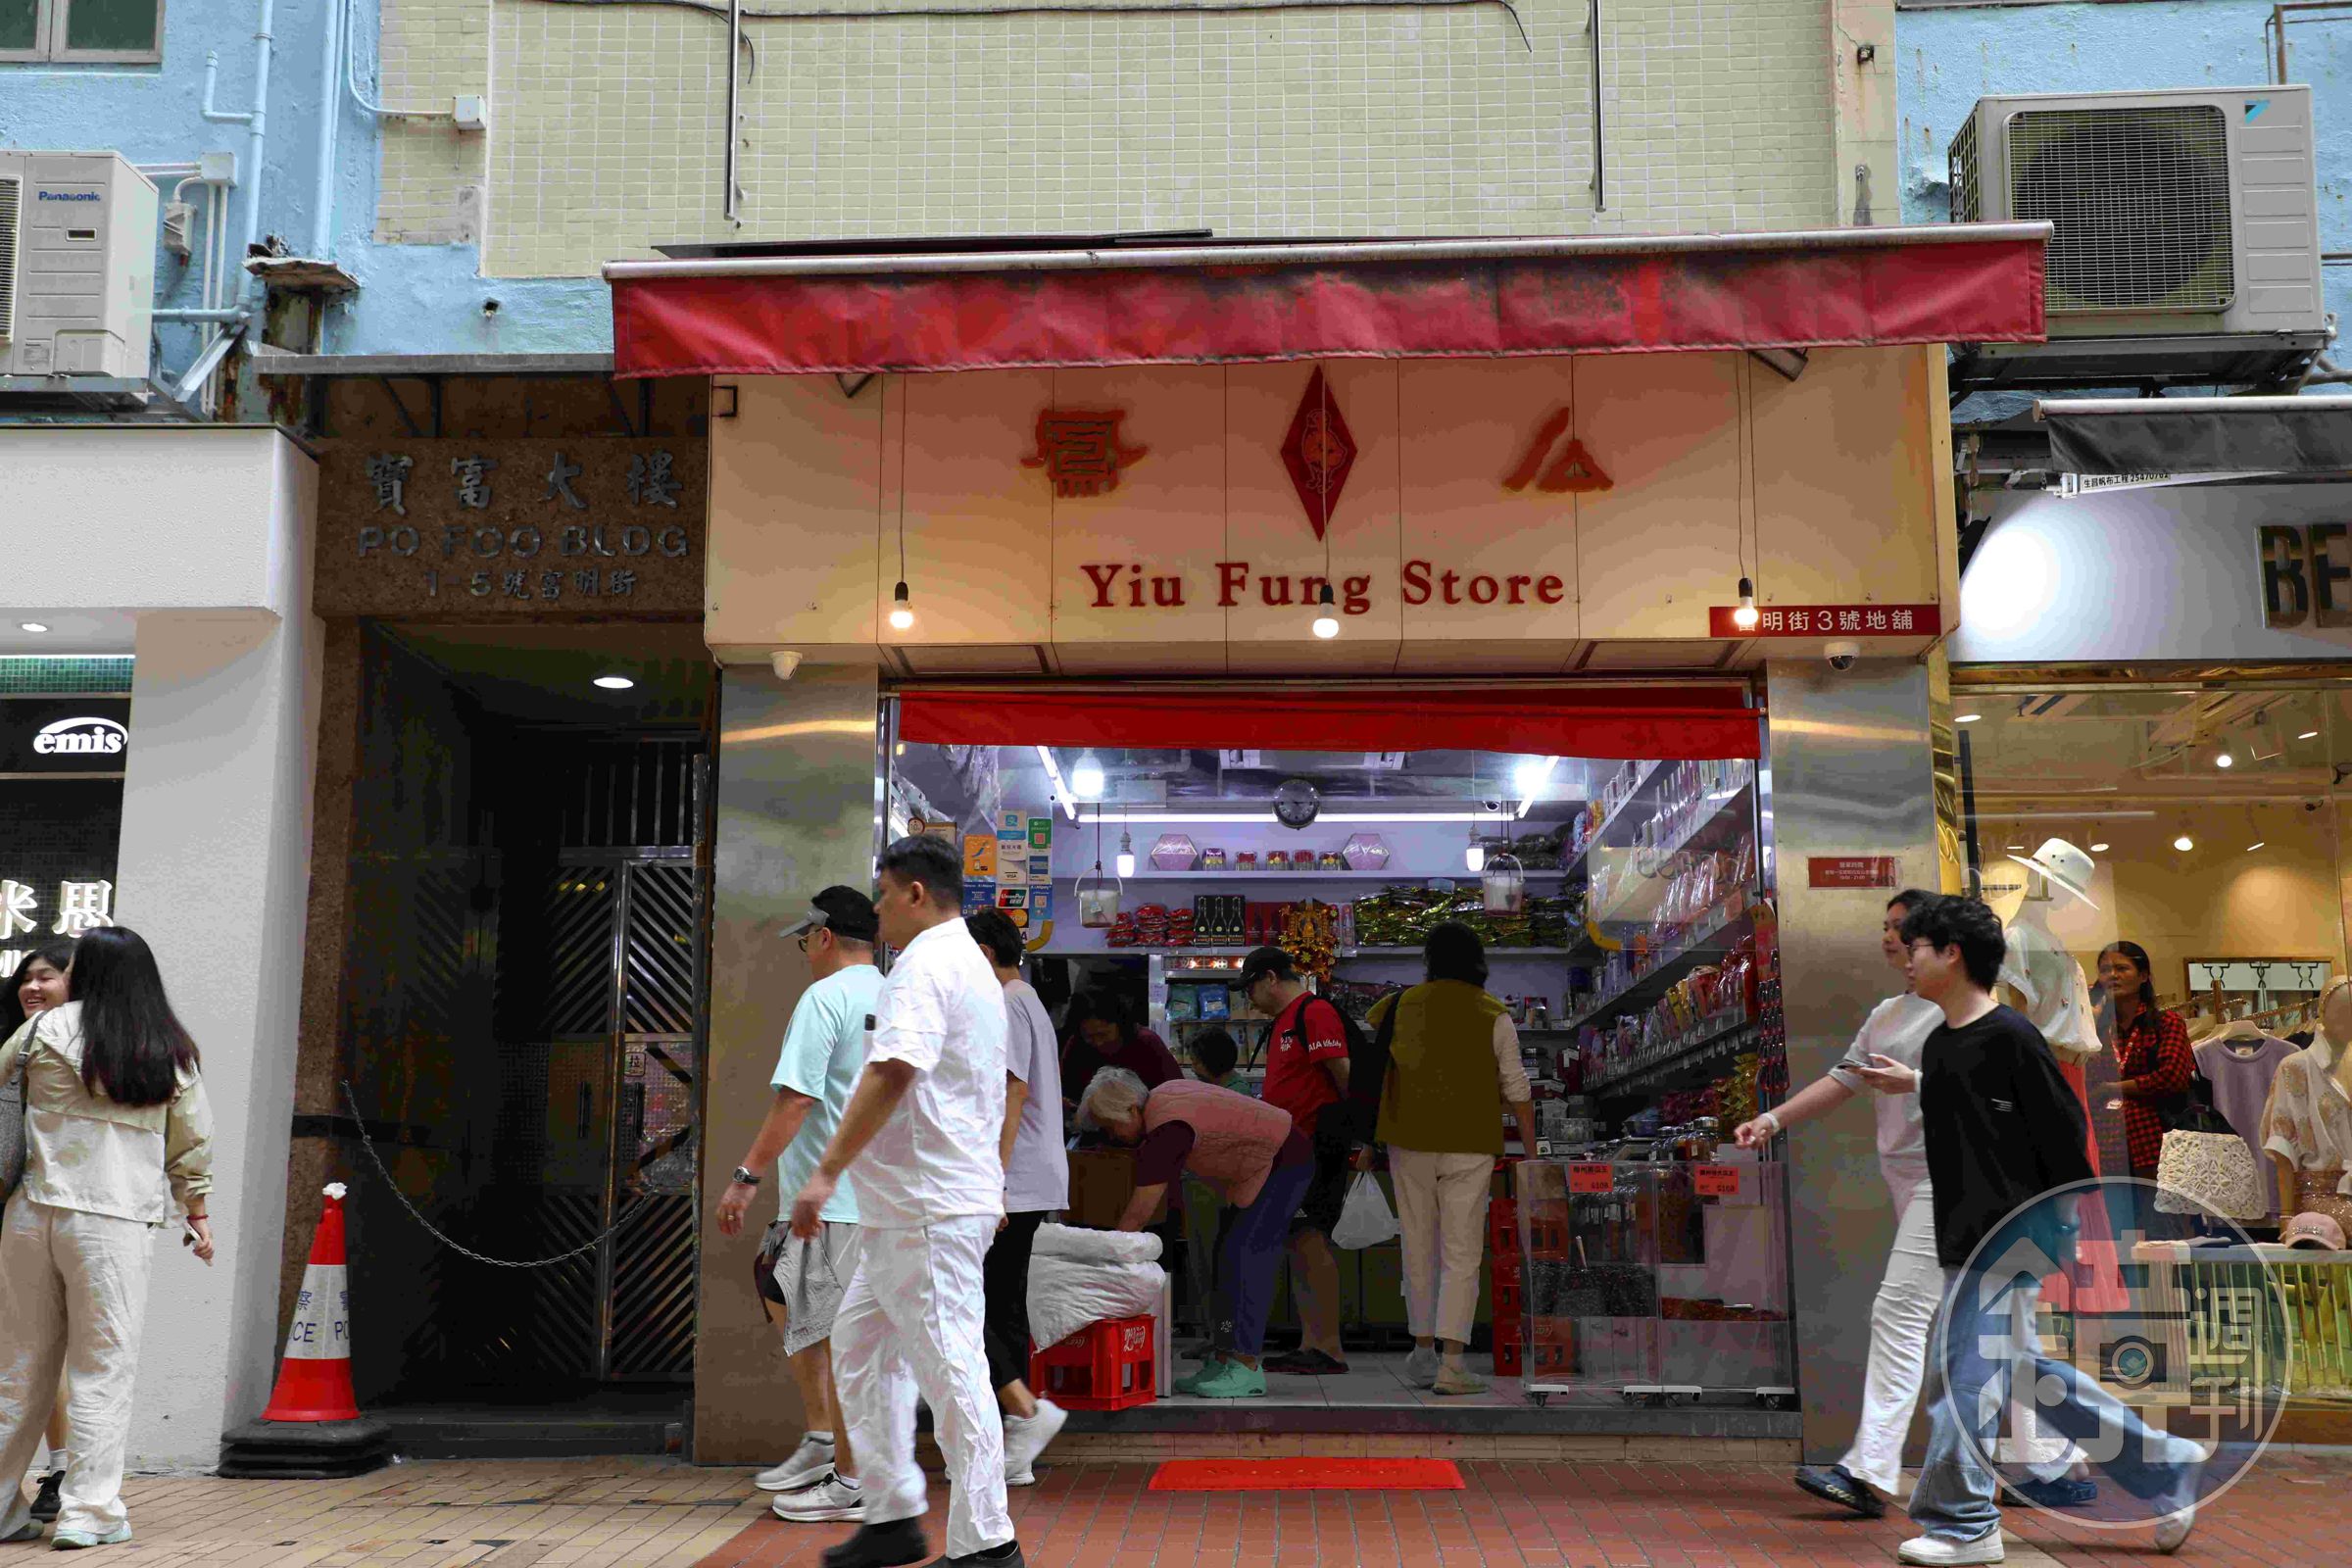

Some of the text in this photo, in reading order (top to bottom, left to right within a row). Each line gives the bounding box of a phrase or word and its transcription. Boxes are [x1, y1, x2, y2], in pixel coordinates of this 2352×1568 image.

[38, 190, 101, 203] Panasonic
[365, 452, 683, 515] 寶富大樓
[358, 524, 689, 558] PO FOO BLDG
[1081, 560, 1565, 614] Yiu Fung Store
[33, 725, 123, 754] emis
